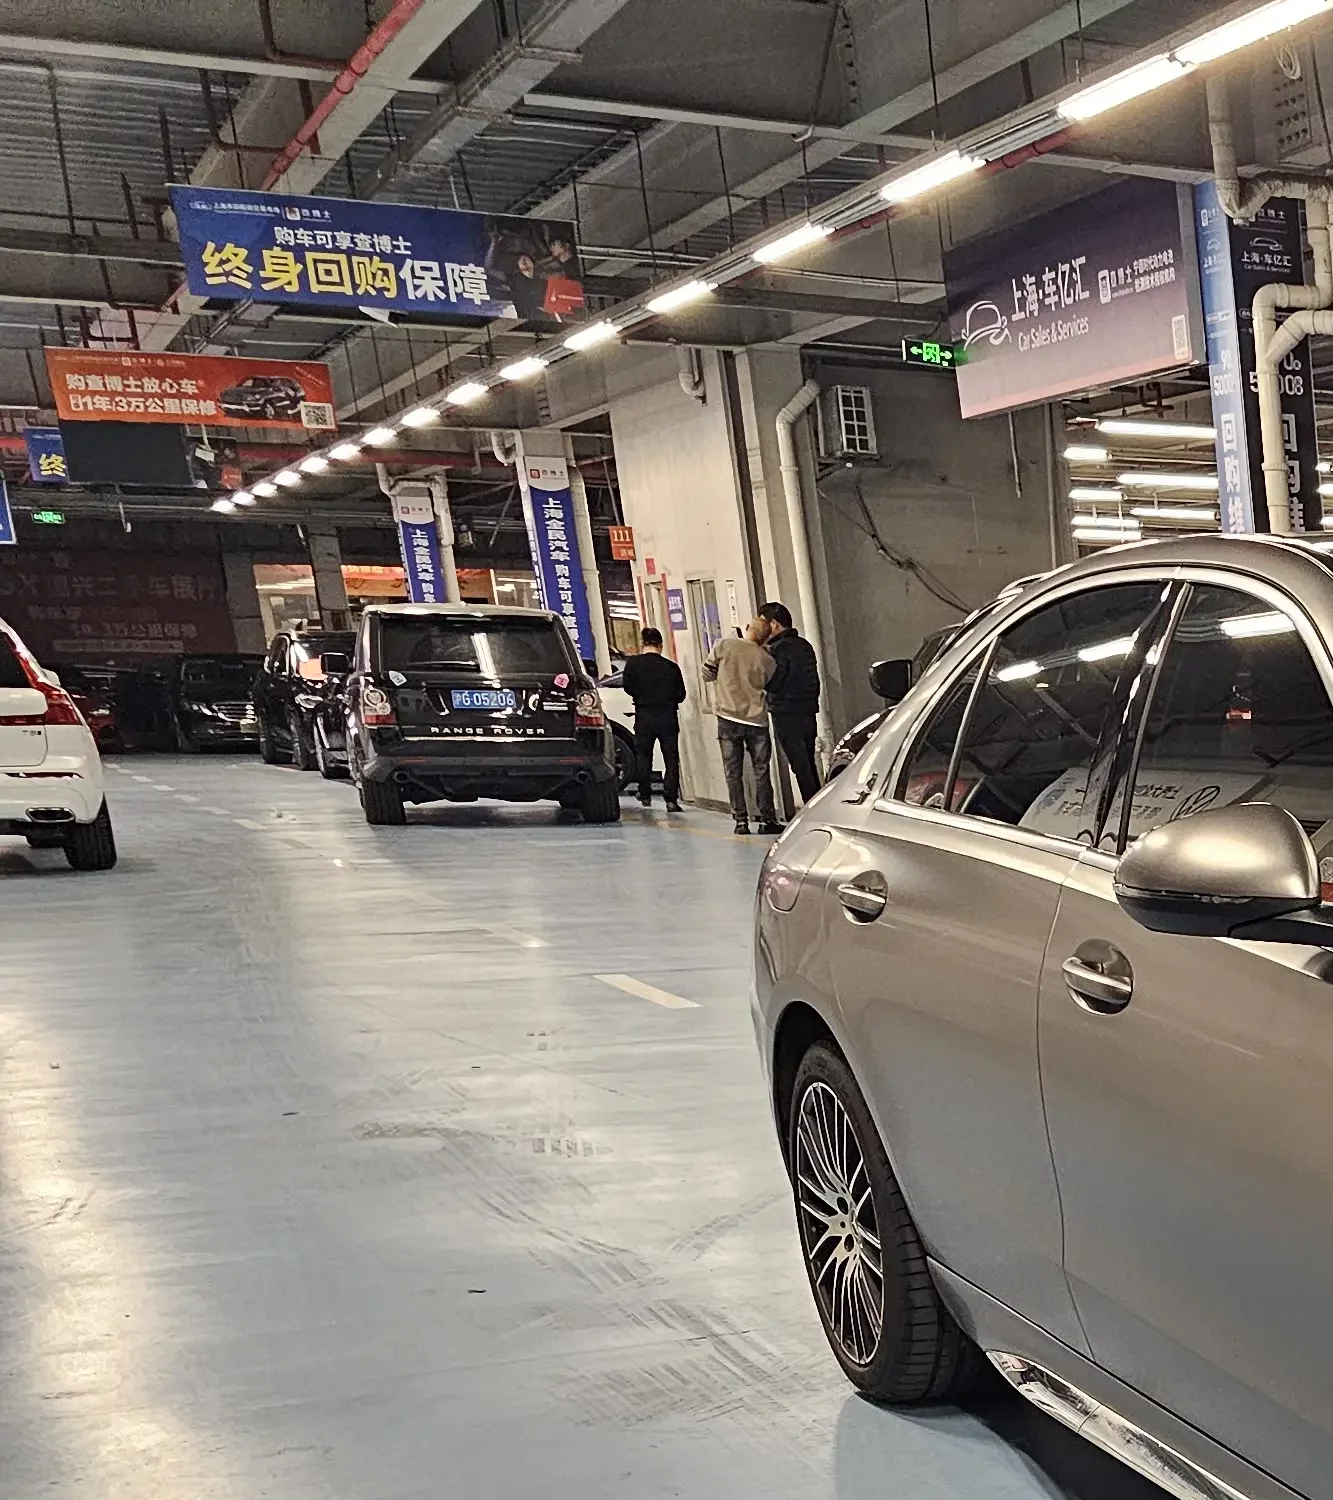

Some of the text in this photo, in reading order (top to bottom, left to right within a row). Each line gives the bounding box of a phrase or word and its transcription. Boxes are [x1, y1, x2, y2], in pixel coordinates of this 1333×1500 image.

[274, 226, 412, 255] 购车可享查博士
[201, 241, 491, 305] 终身回购保障
[1018, 332, 1031, 352] Car
[1031, 325, 1050, 347] Sales
[1057, 314, 1089, 341] Services
[65, 374, 199, 394] 购查博士放心车
[38, 453, 67, 477] 终
[612, 530, 631, 541] 111
[494, 727, 545, 735] ROVER
